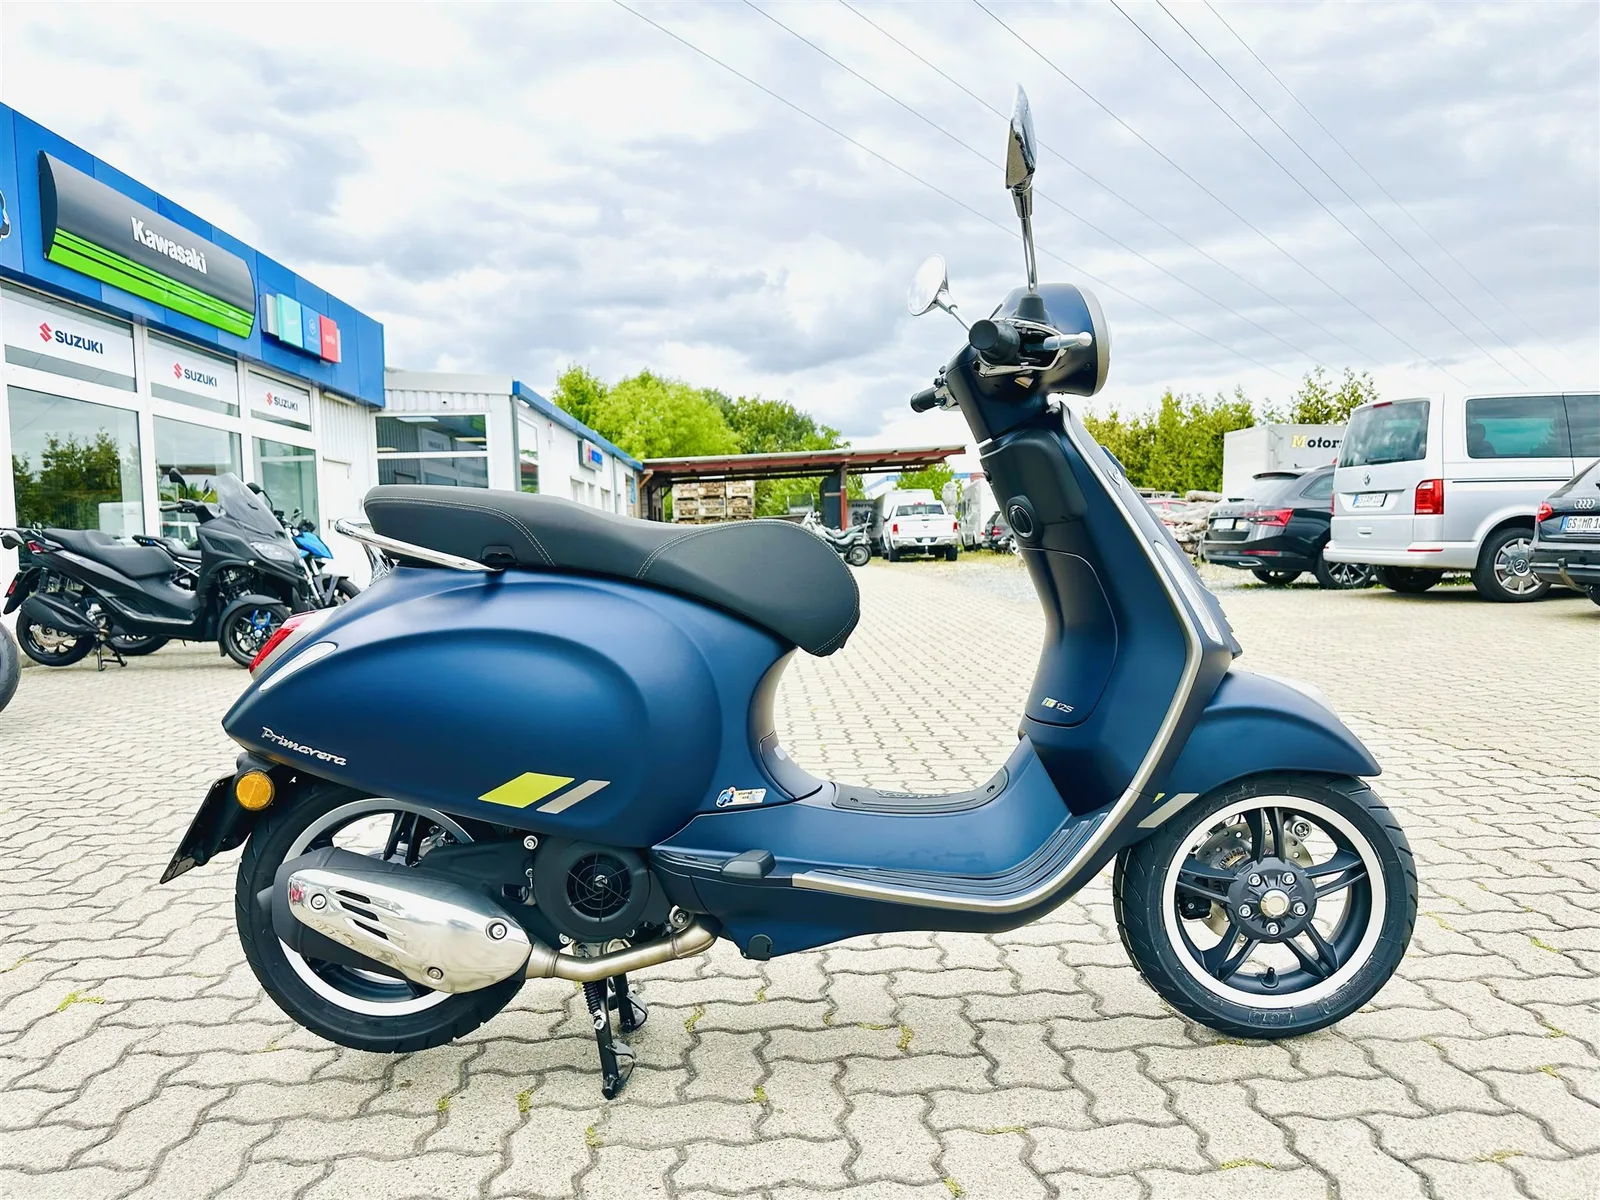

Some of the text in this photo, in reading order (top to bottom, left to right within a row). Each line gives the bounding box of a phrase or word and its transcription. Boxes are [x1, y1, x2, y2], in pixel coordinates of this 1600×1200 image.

[131, 216, 207, 275] Kawasaki
[54, 329, 104, 355] SUZUKI
[184, 368, 218, 387] SUZUKI
[273, 396, 299, 411] SUZUKI
[1291, 434, 1343, 449] Motor
[261, 726, 347, 766] Primavera
